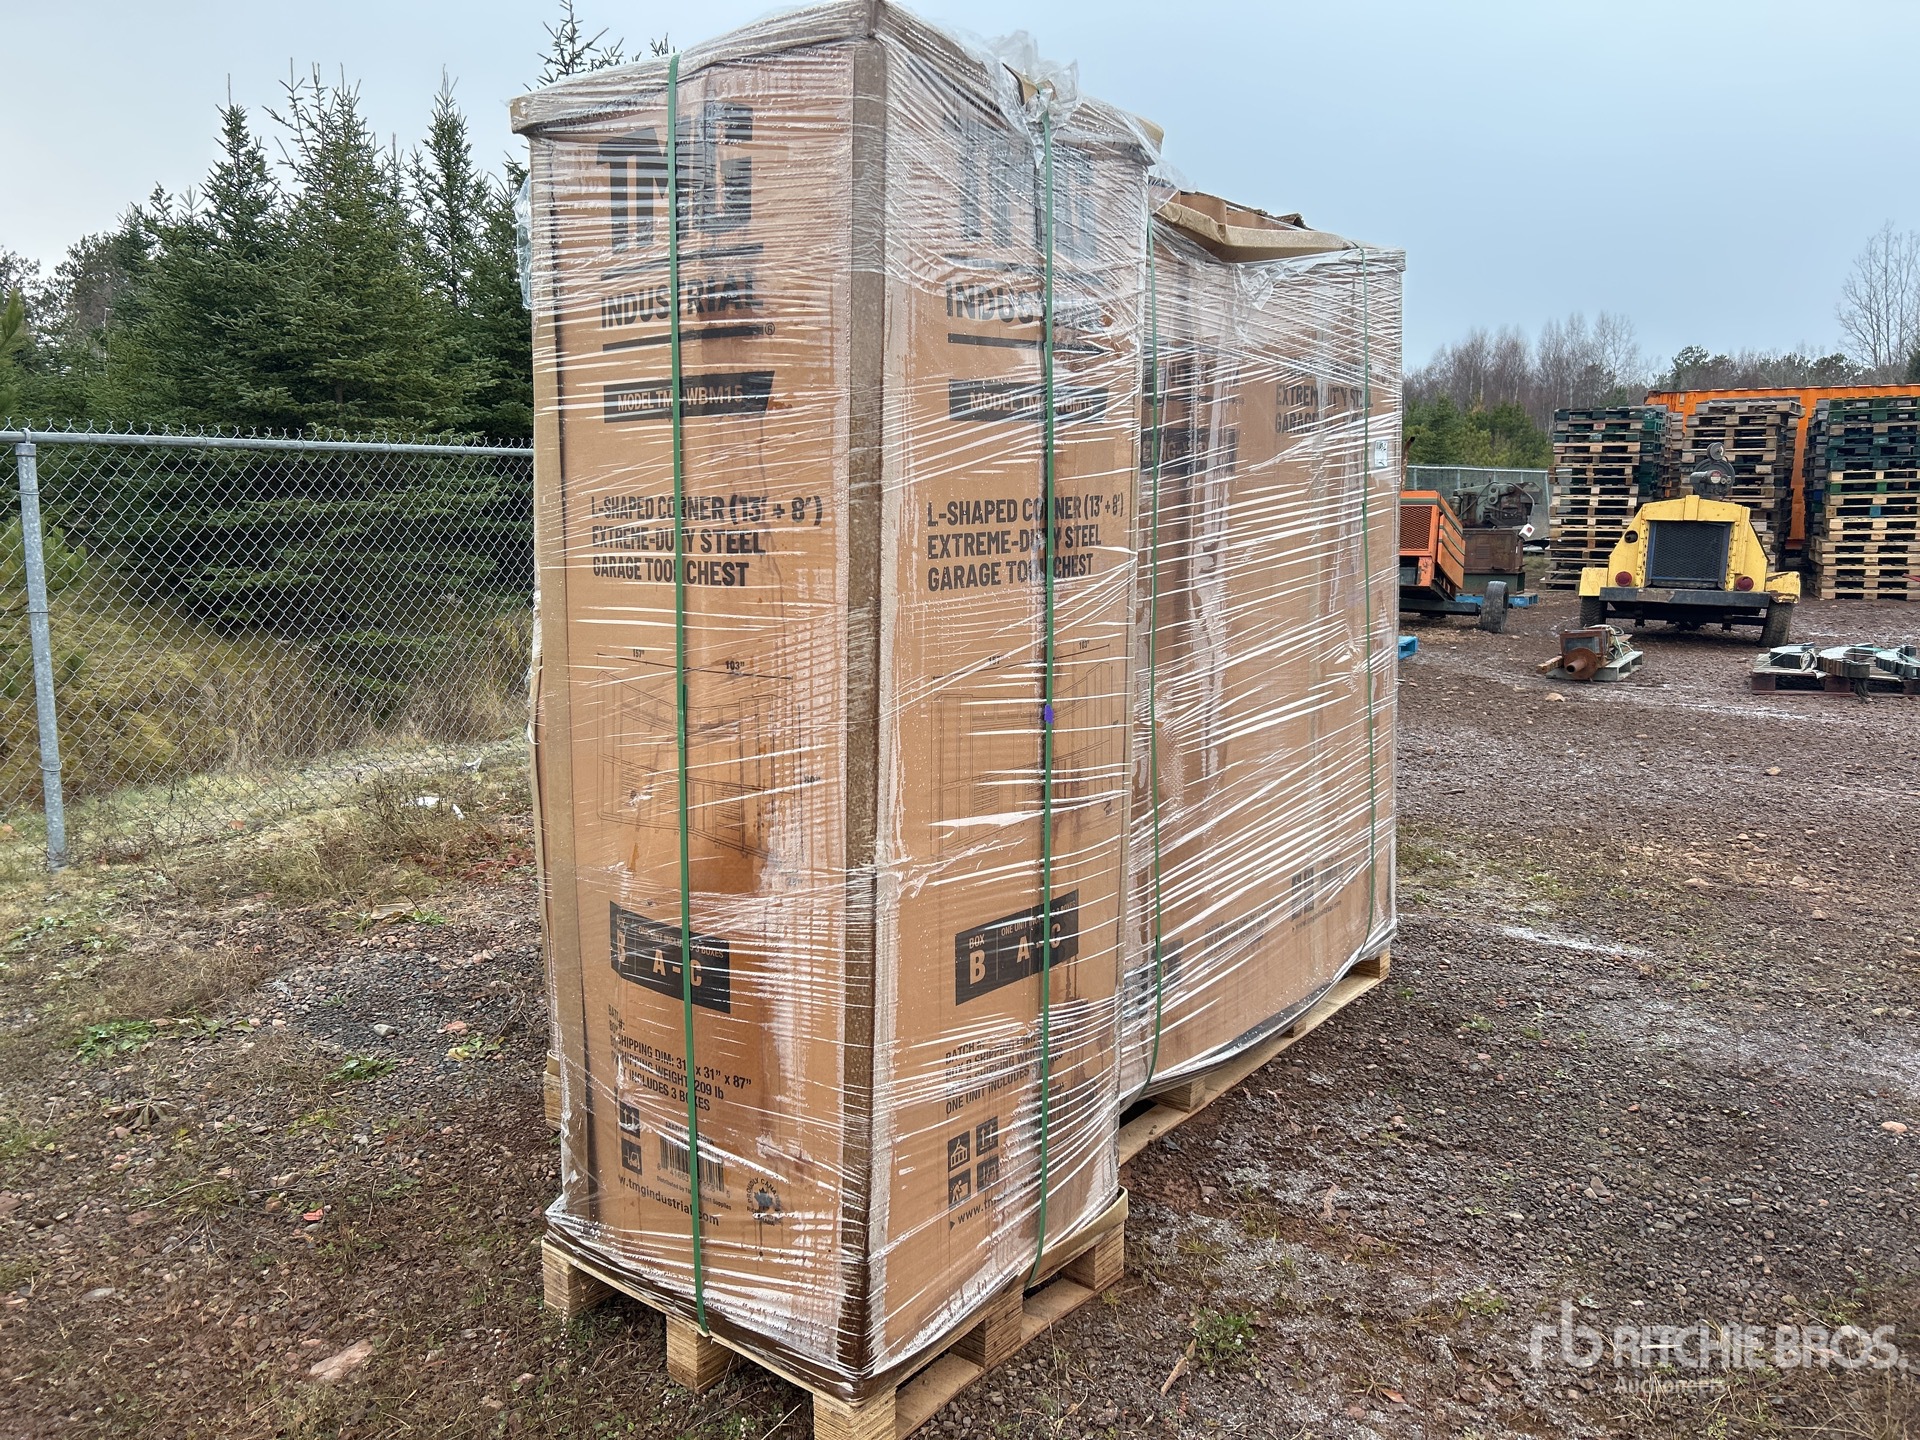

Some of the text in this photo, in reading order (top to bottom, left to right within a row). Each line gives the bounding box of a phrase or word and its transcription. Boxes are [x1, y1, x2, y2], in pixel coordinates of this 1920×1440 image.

[617, 384, 744, 412] MODEL TM-WBM15
[1350, 387, 1374, 409] STEL
[591, 496, 654, 519] L-SHAPED
[772, 503, 785, 519] +
[927, 498, 1018, 527] L-SHAPED
[1022, 496, 1082, 522] CONER
[1105, 500, 1111, 513] +
[700, 529, 768, 556] STEEL
[1064, 523, 1102, 549] STEEL
[592, 556, 642, 580] GARAGE
[686, 560, 750, 587] CHEST
[927, 561, 1002, 592] GARAGE
[1053, 553, 1094, 579] CHEST
[968, 934, 985, 949] BOX
[1000, 926, 1014, 937] ONE
[1014, 920, 1028, 933] UNIT
[652, 949, 667, 977] A
[690, 958, 703, 987] C
[969, 950, 986, 985] B
[1016, 935, 1031, 963] A
[1050, 923, 1062, 949] C
[679, 1089, 711, 1112] BES
[694, 1079, 712, 1096] 209
[945, 1097, 964, 1115] ONE
[965, 1084, 986, 1103] UNIT
[987, 1066, 1030, 1094] INCLUDES
